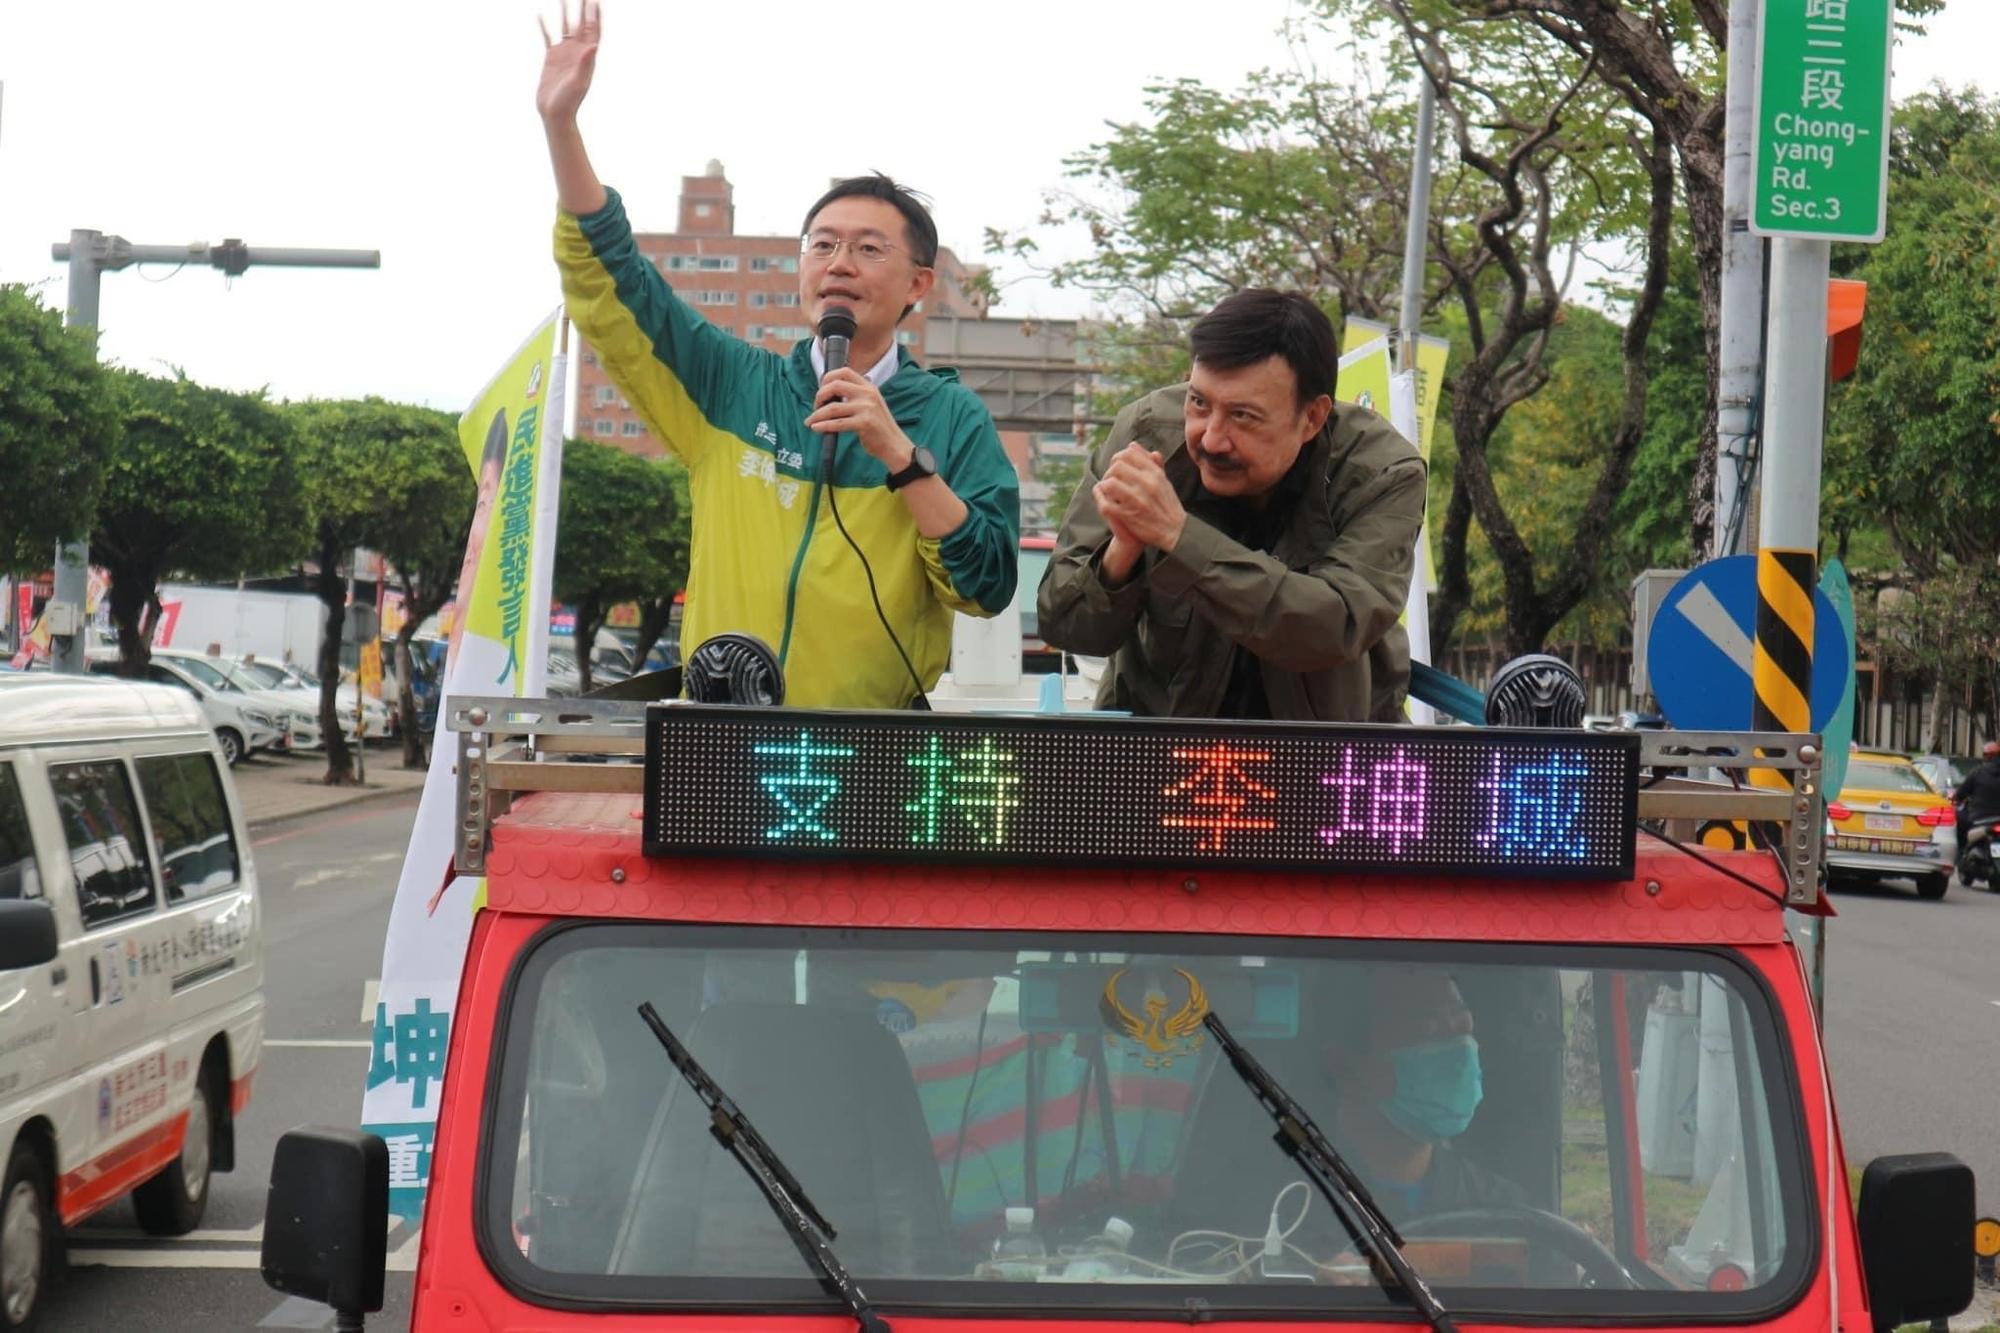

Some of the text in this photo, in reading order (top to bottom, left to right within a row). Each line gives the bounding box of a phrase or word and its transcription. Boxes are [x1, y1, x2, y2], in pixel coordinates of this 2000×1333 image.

[1774, 113, 1869, 146] Chong-
[1773, 143, 1834, 169] yang
[1772, 167, 1812, 190] Rd.
[1770, 194, 1841, 220] Sec.3
[496, 407, 538, 685] 民進黨發言人
[753, 729, 1590, 862] 支持 李坤城
[366, 998, 449, 1108] 坤
[384, 1133, 431, 1188] 重
